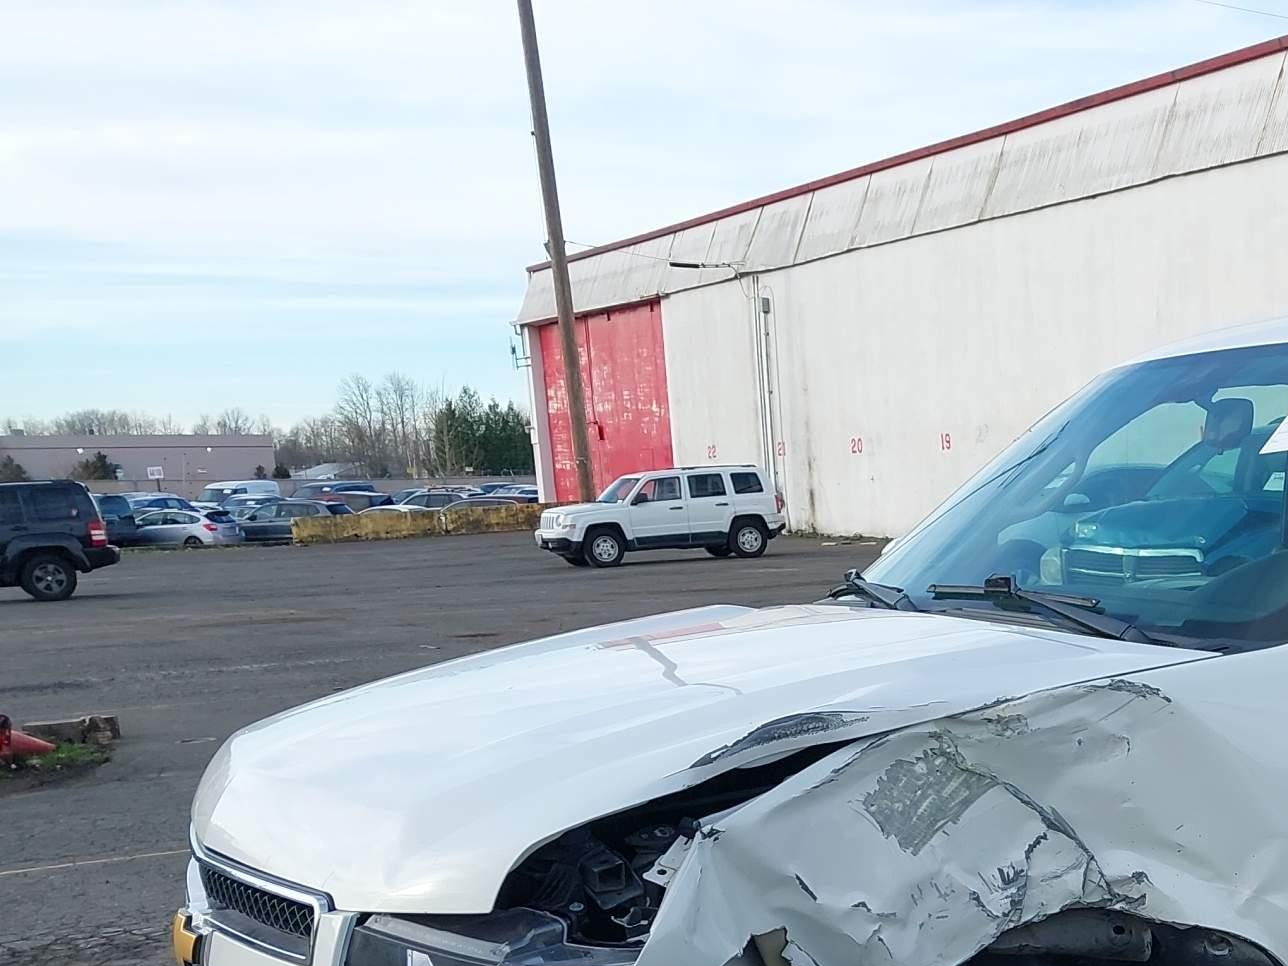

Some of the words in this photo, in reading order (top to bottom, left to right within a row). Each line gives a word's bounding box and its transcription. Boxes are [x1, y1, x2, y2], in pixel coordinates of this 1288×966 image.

[850, 437, 863, 454] 20
[940, 433, 952, 450] 19
[707, 444, 717, 459] 22
